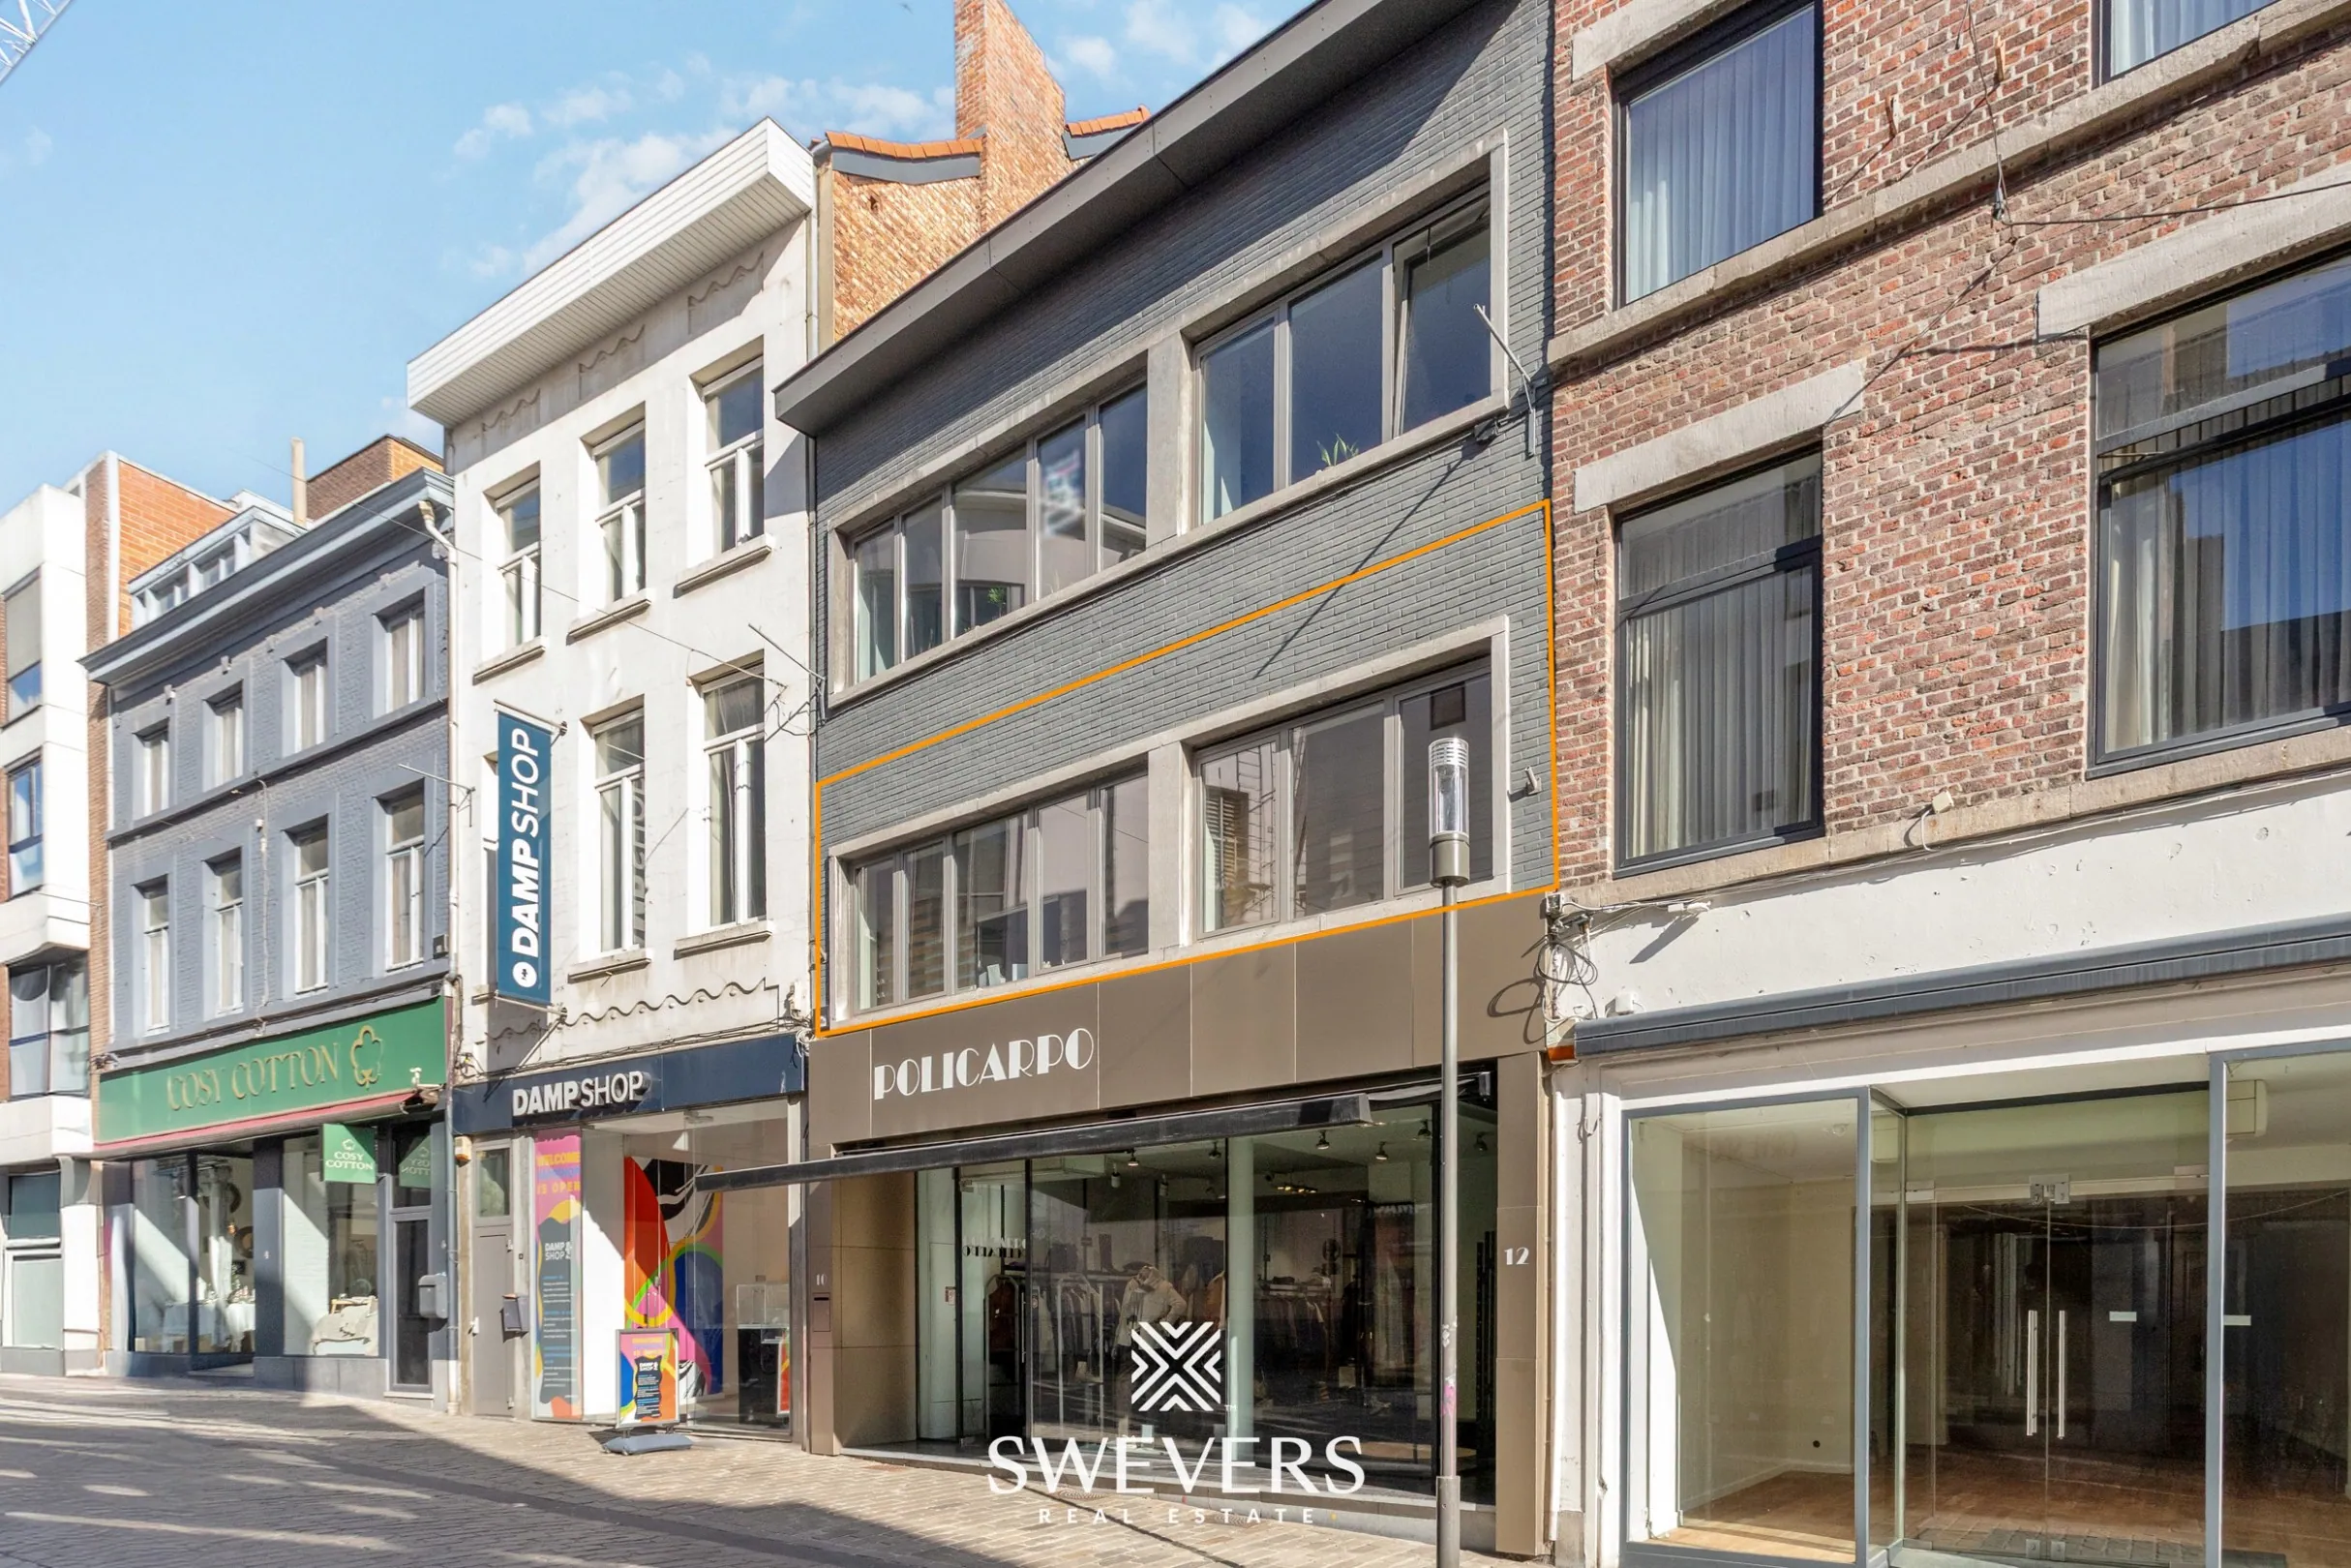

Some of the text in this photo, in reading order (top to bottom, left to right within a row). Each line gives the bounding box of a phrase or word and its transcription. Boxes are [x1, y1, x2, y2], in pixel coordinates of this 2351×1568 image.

[511, 727, 539, 958] DAMPSHOP
[231, 1042, 339, 1100] COTTON
[874, 1028, 1094, 1101] POLICARPO
[512, 1070, 646, 1117] DAMPSHOP
[333, 1151, 364, 1161] COSY
[325, 1160, 374, 1170] COTTON
[551, 1180, 581, 1194] OPEN
[544, 1242, 565, 1252] DAMP
[545, 1251, 565, 1260] SHOP
[1503, 1246, 1530, 1266] 12
[816, 1273, 828, 1286] 10
